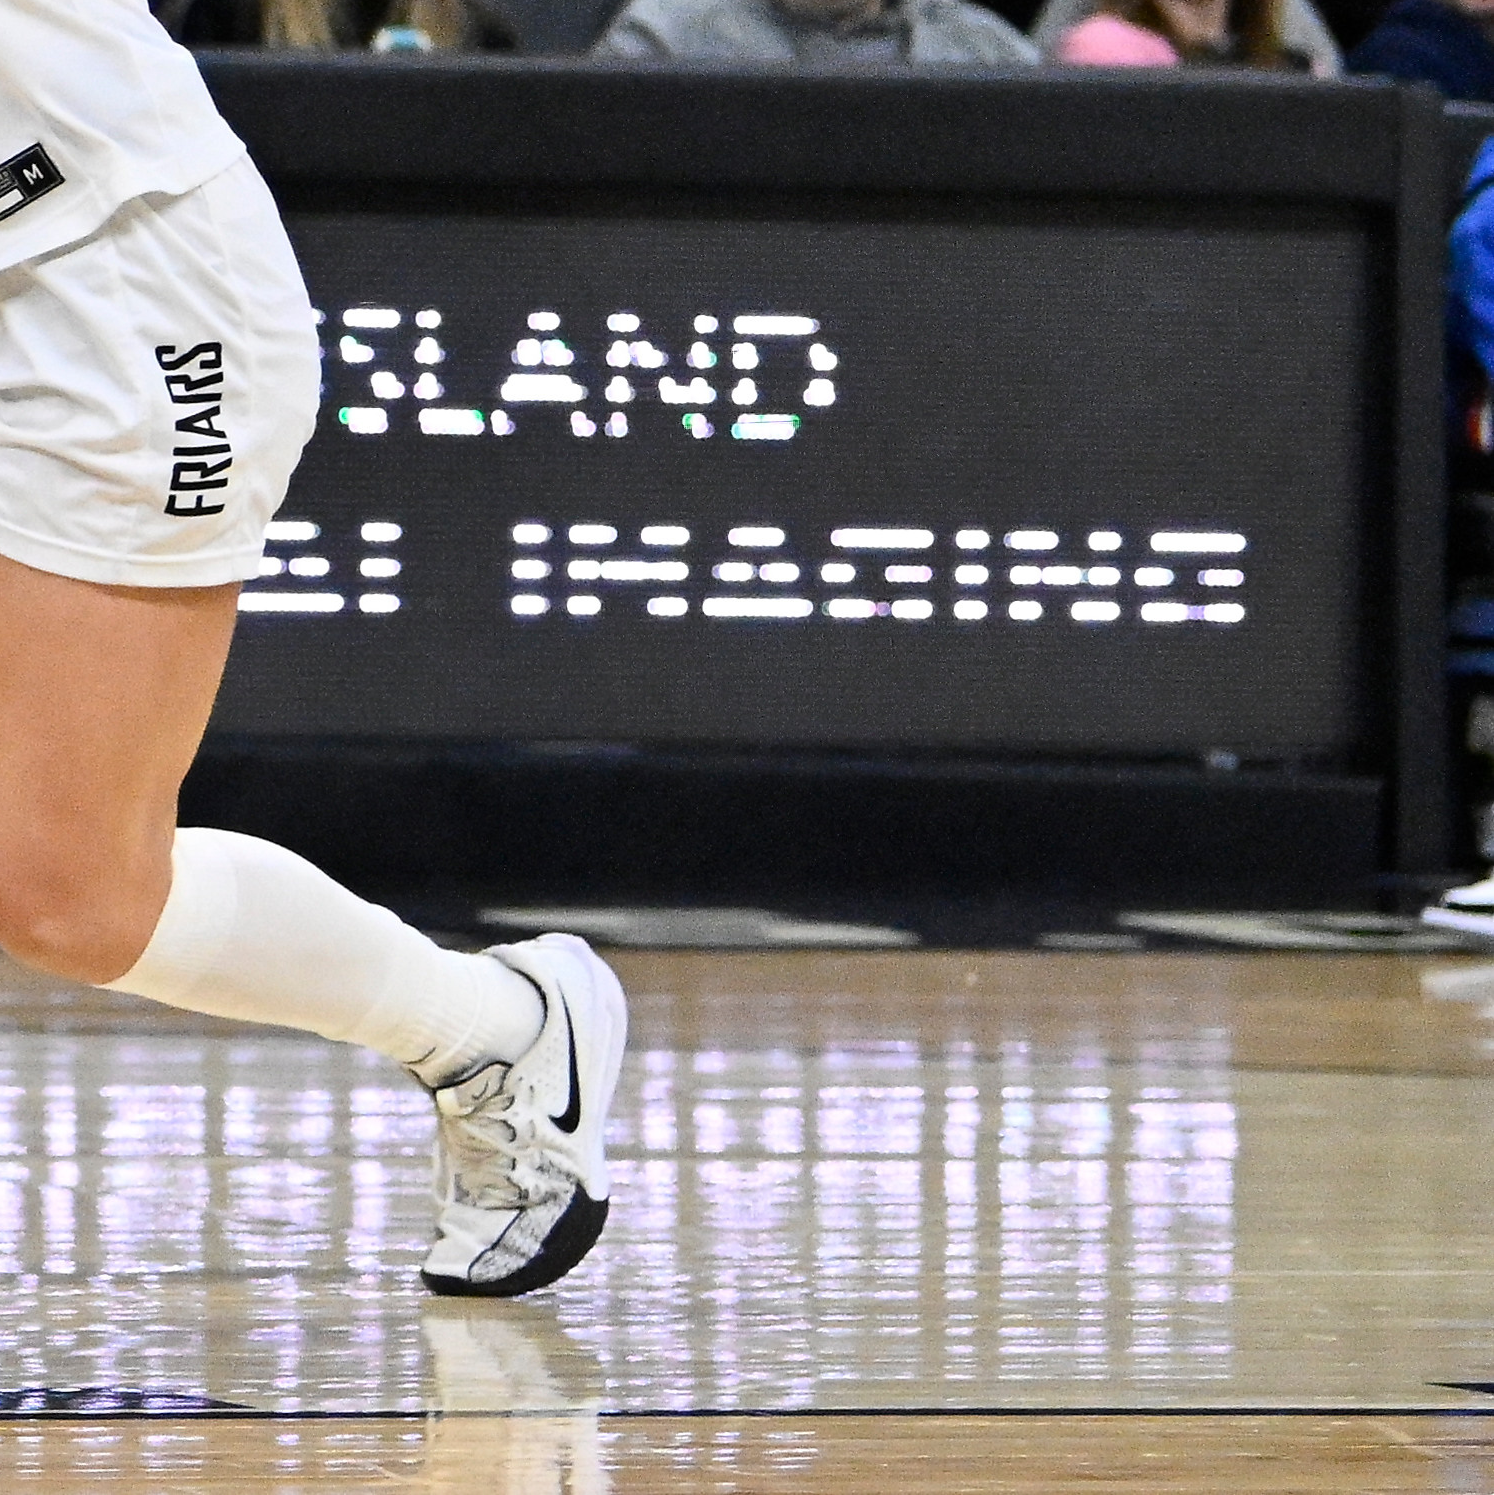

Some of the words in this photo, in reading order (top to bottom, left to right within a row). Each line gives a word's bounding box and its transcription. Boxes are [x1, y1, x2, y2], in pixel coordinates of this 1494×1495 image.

[22, 163, 44, 185] M
[155, 341, 233, 517] FRIARS
[312, 307, 838, 439] SLAND
